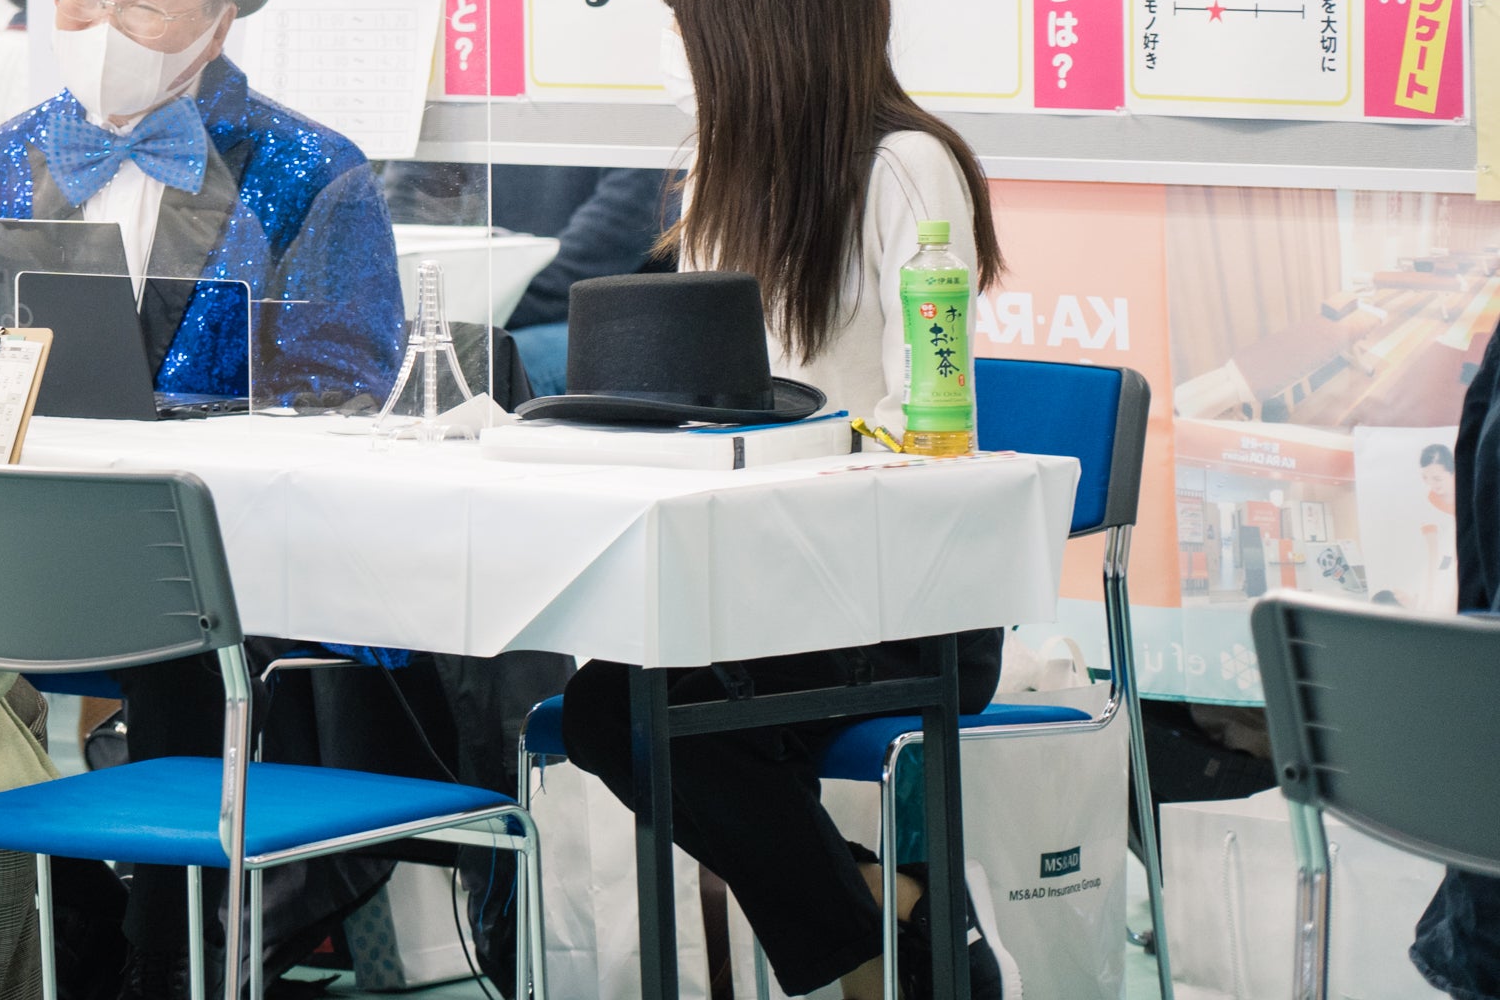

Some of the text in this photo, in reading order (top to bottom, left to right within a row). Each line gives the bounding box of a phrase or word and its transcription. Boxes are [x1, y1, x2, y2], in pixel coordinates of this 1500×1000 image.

[1044, 852, 1079, 873] MS&AD
[1009, 878, 1101, 902] MS&AD Insurance Group
